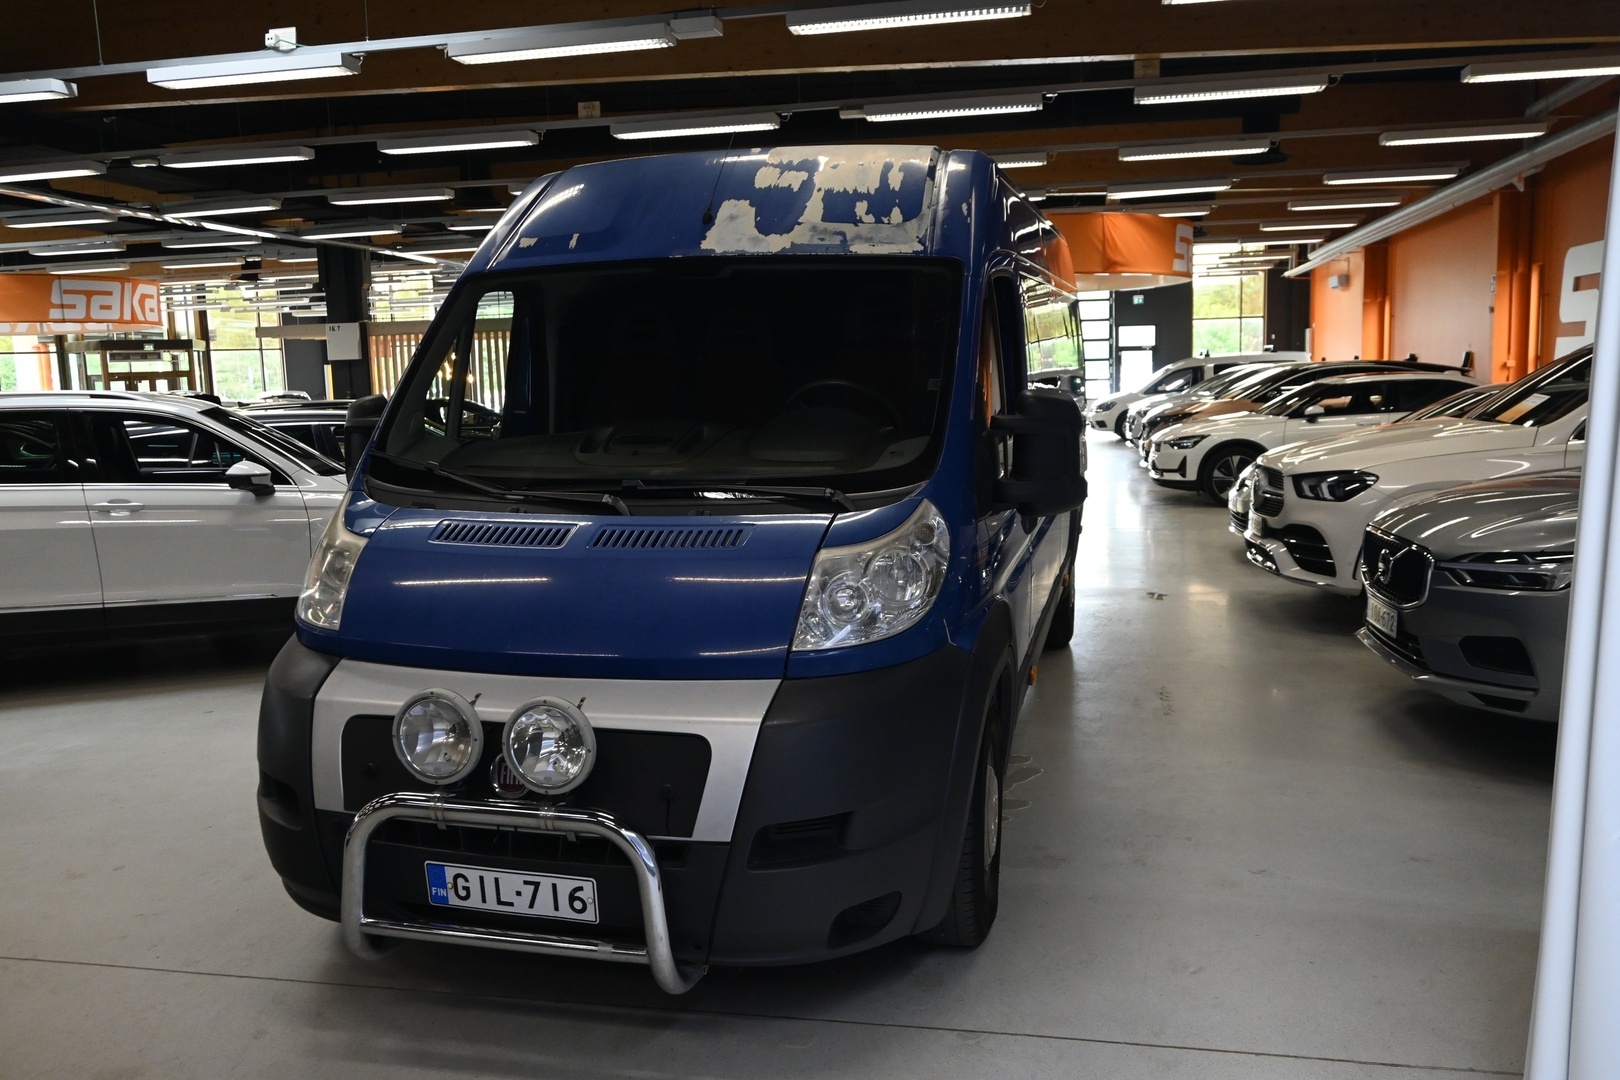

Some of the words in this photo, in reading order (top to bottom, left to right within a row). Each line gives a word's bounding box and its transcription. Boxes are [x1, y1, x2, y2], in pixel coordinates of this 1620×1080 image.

[500, 762, 523, 785] FIA
[432, 887, 447, 897] FIN
[453, 873, 587, 914] GIL-716
